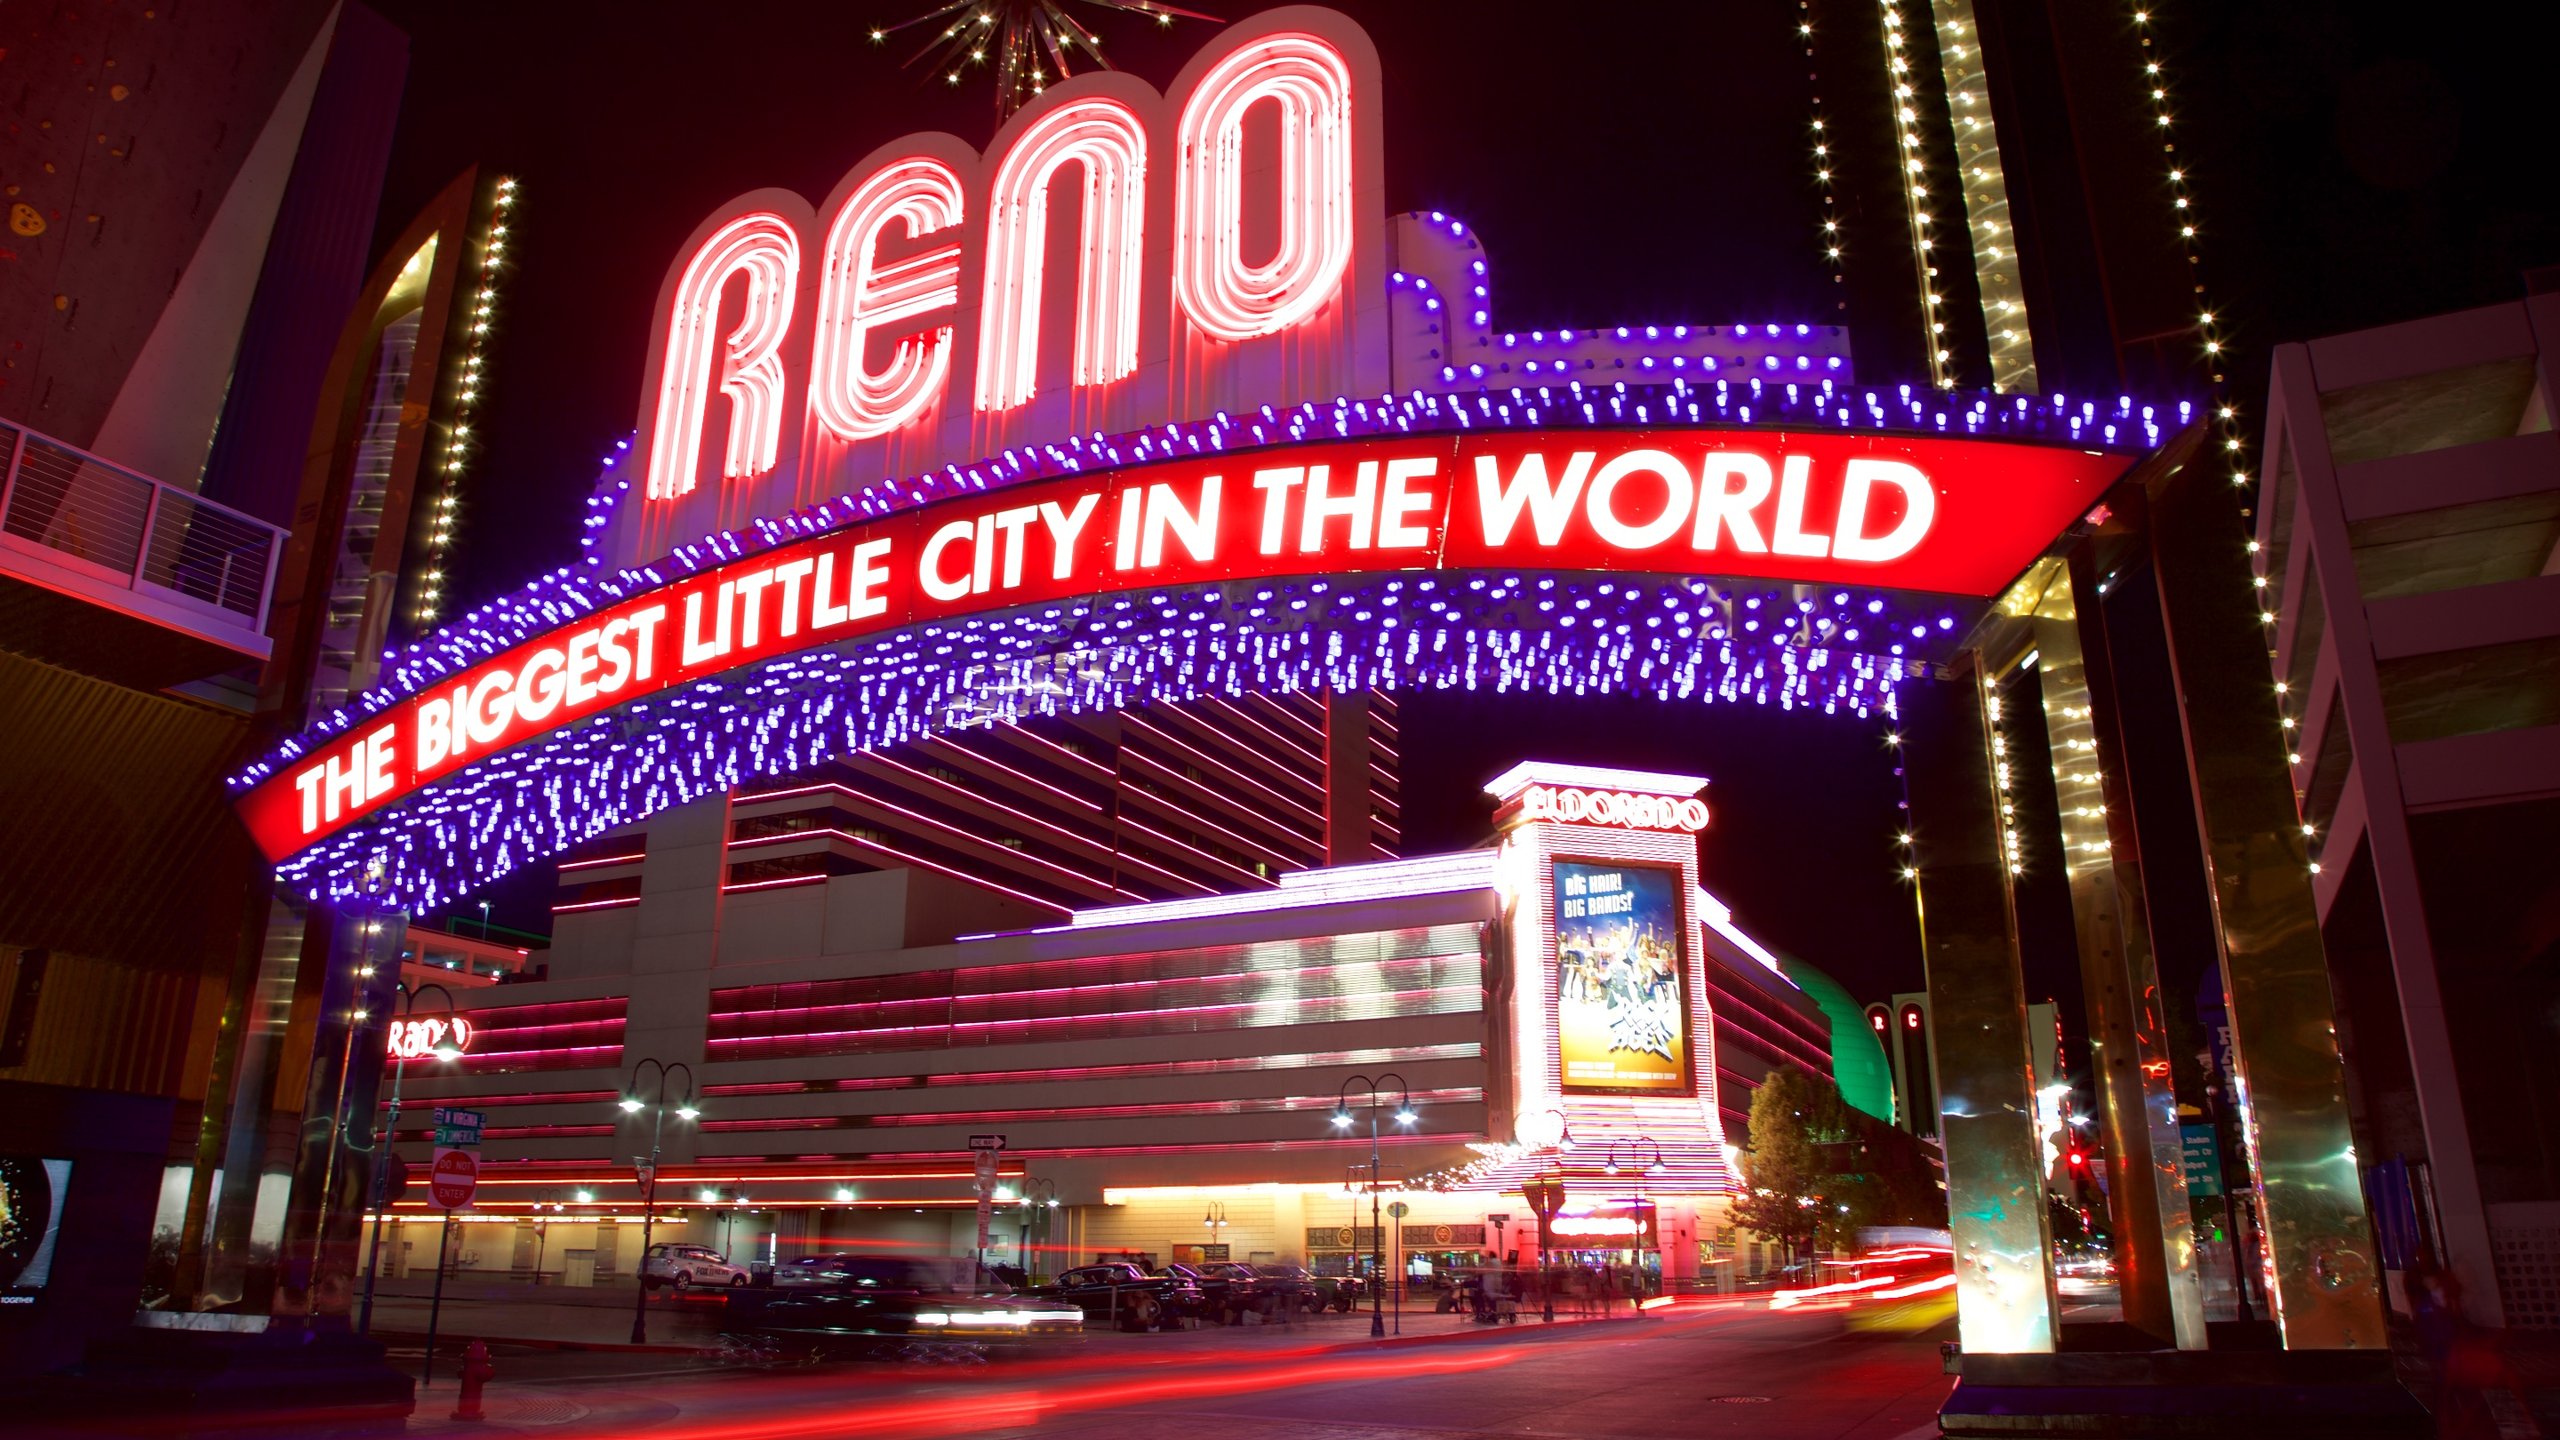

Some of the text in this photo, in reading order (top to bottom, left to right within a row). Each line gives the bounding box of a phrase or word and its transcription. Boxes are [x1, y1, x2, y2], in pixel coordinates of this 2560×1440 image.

[645, 32, 1353, 502] RENO
[296, 450, 1936, 833] THE BIGGEST LITTLE CITY IN THE WORLD
[1565, 873, 1622, 896] BIG HAIR!
[1564, 892, 1632, 918] BIG BANDS!
[440, 1159, 472, 1171] DO NOT
[440, 1188, 465, 1199] ENTER
